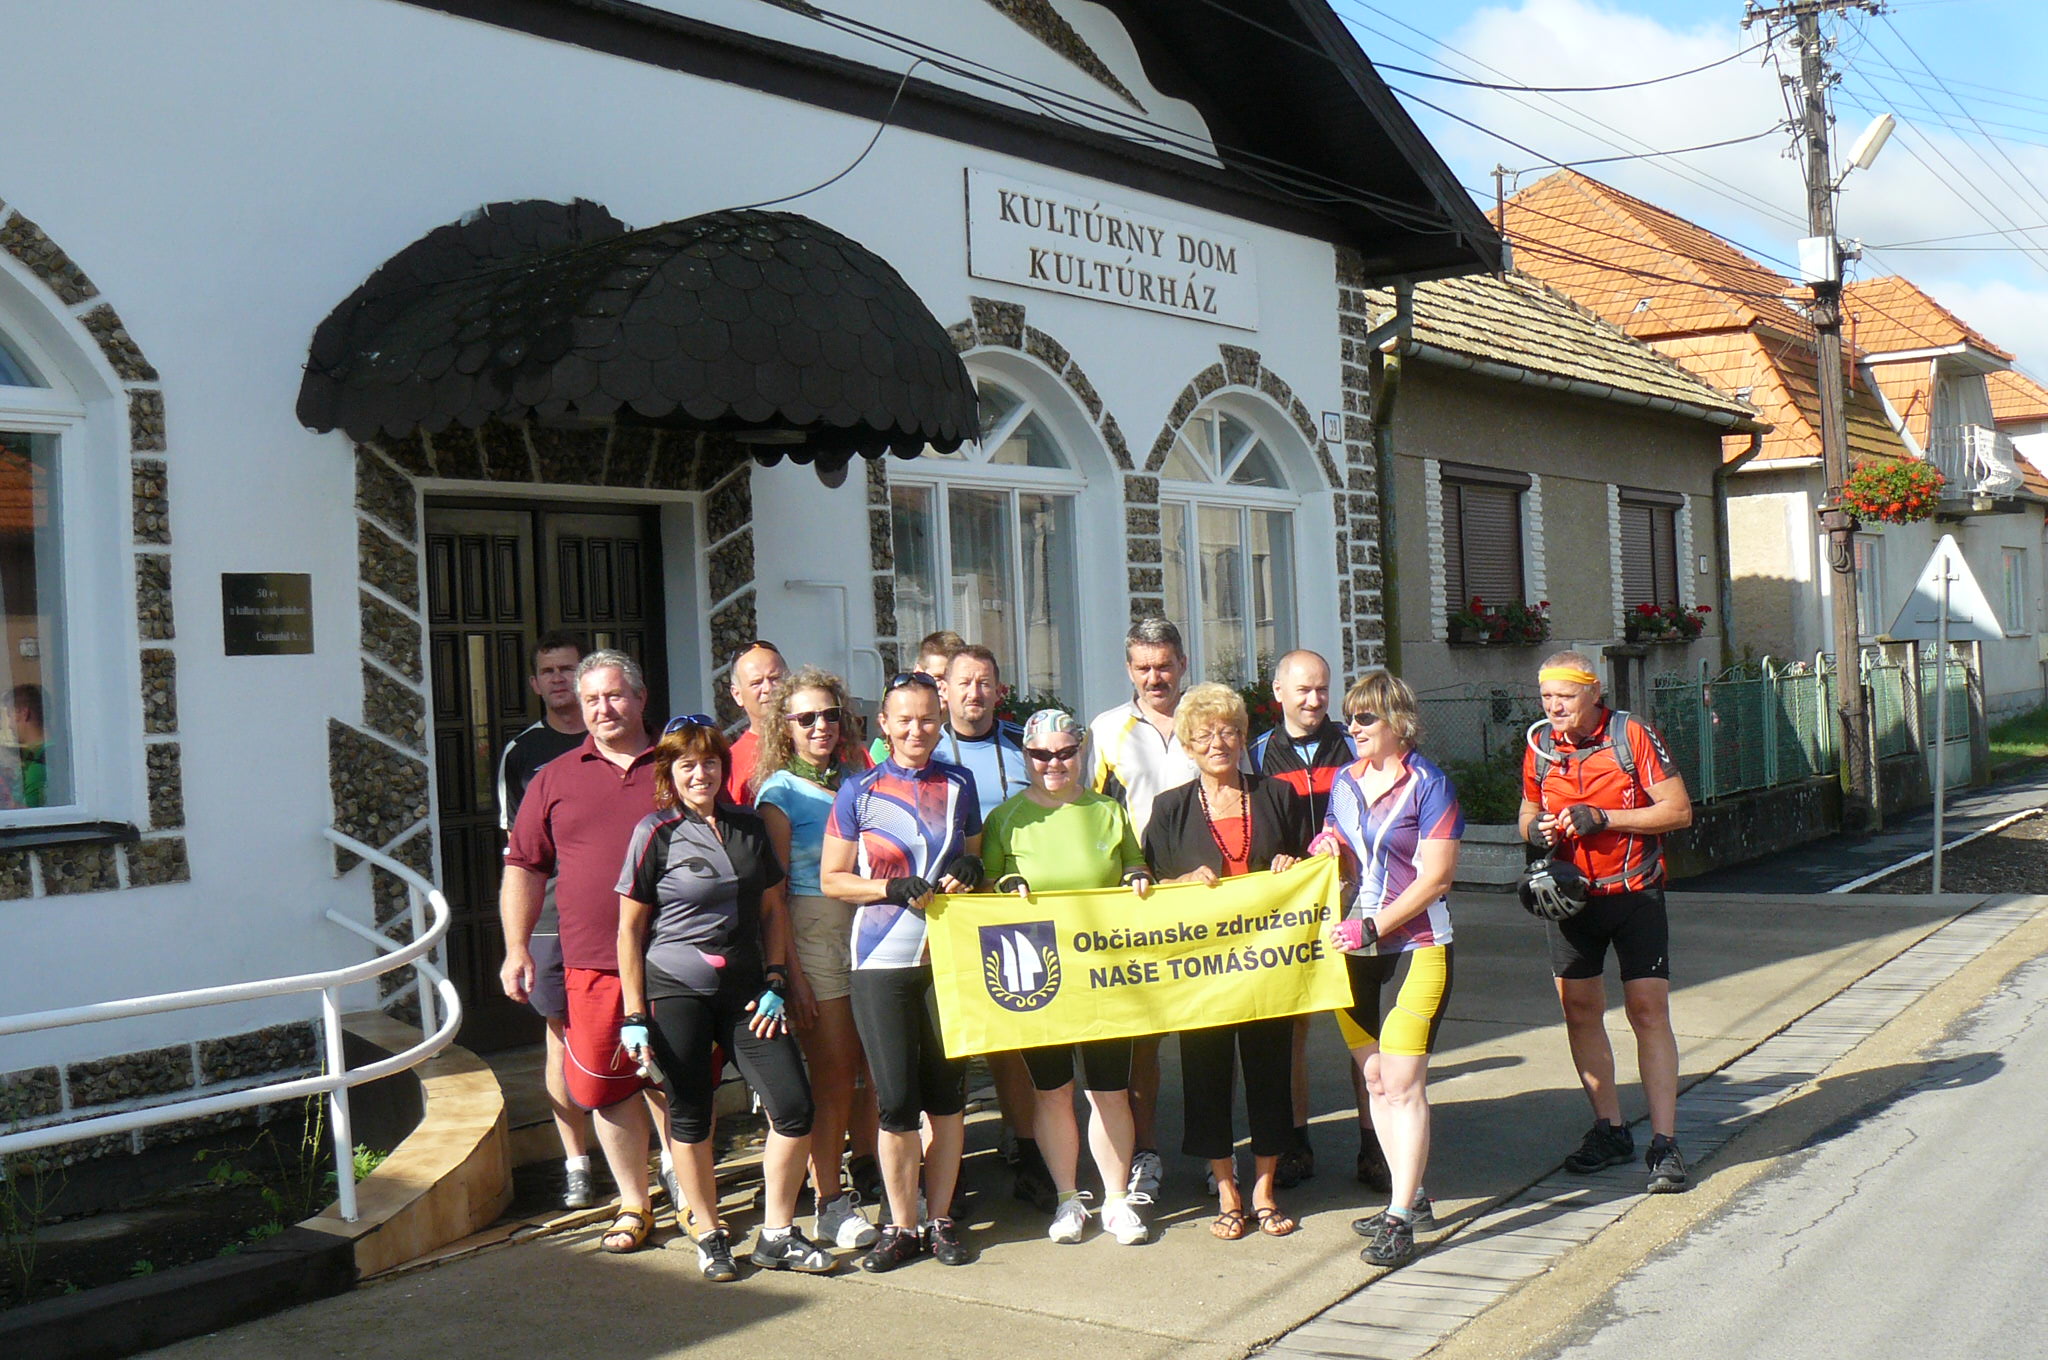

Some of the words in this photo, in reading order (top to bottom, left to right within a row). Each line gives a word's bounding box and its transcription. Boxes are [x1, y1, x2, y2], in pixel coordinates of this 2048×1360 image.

[998, 188, 1165, 258] KULTÚRNY
[1177, 233, 1238, 275] DOM
[1029, 247, 1218, 315] KULTÚRHÁZ
[1073, 921, 1209, 953] Občianske
[1216, 903, 1332, 938] združenie
[1089, 959, 1160, 989] NAŠE
[1166, 939, 1325, 980] TOMÁŠOVCE
